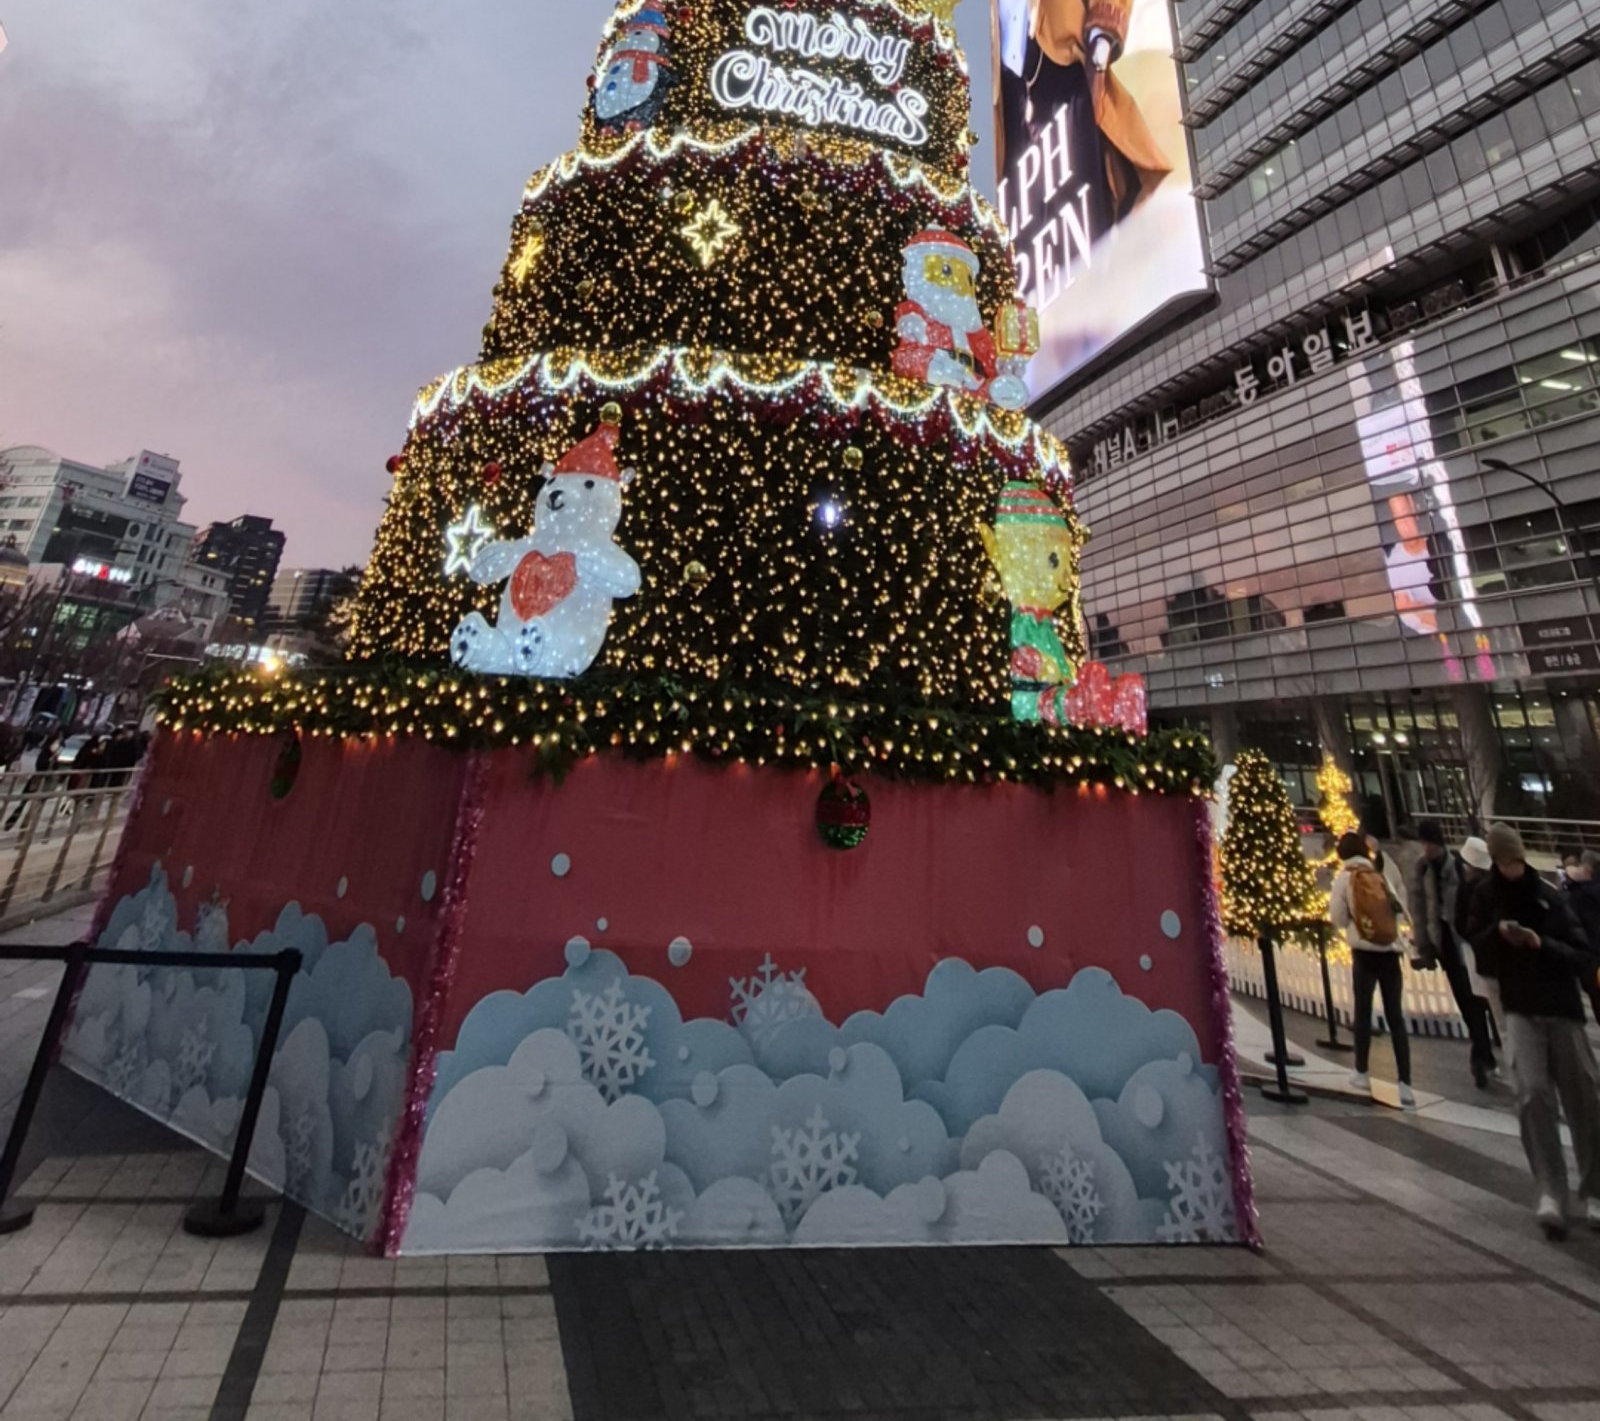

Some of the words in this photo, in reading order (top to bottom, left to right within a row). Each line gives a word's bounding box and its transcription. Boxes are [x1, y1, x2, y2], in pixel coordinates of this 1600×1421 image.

[746, 6, 911, 84] Merry
[711, 50, 929, 146] Christmas
[1233, 310, 1381, 407] 동아일보
[1093, 425, 1138, 475] 채널A
